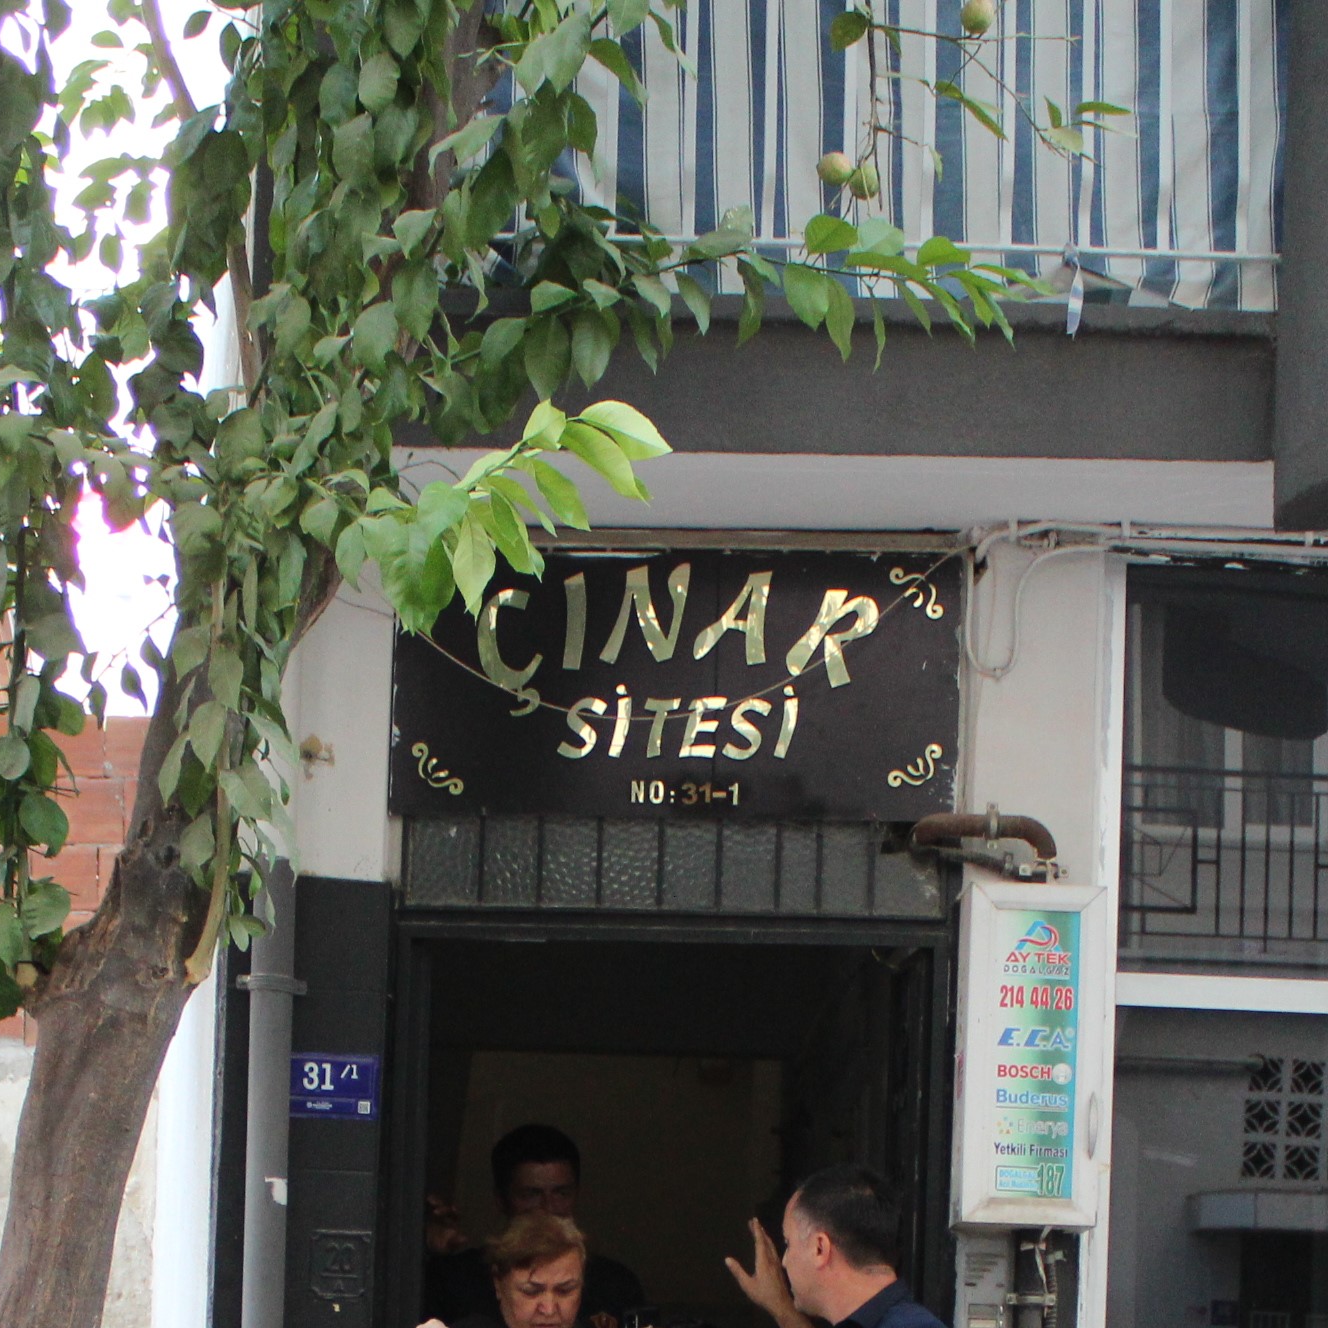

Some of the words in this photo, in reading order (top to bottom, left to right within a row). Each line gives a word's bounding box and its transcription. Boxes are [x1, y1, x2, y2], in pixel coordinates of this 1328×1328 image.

[478, 562, 879, 716] ÇINAR
[557, 685, 799, 759] SİTESİ
[999, 984, 1024, 1009] 214
[1030, 985, 1050, 1010] 44
[1054, 986, 1074, 1011] 26
[997, 1064, 1051, 1080] BOSCH
[996, 1088, 1068, 1106] Buderus
[994, 1142, 1026, 1156] Yetkili
[1037, 1163, 1065, 1196] 187
